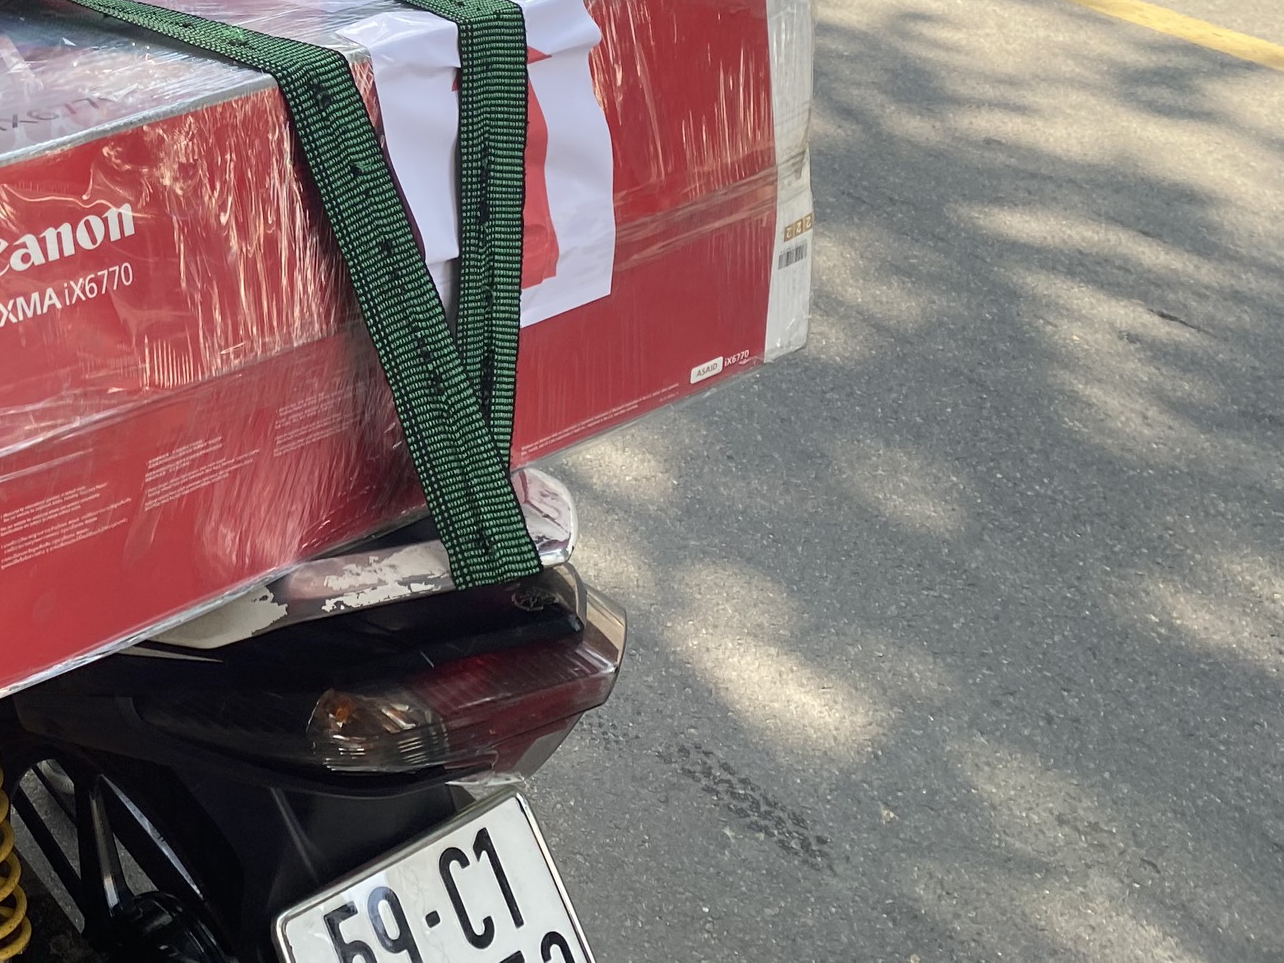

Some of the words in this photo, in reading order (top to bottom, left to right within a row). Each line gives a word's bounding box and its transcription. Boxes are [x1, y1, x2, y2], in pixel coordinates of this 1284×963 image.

[63, 262, 134, 306] iX6770
[724, 349, 750, 367] iX6770
[323, 826, 525, 963] 59-C1
